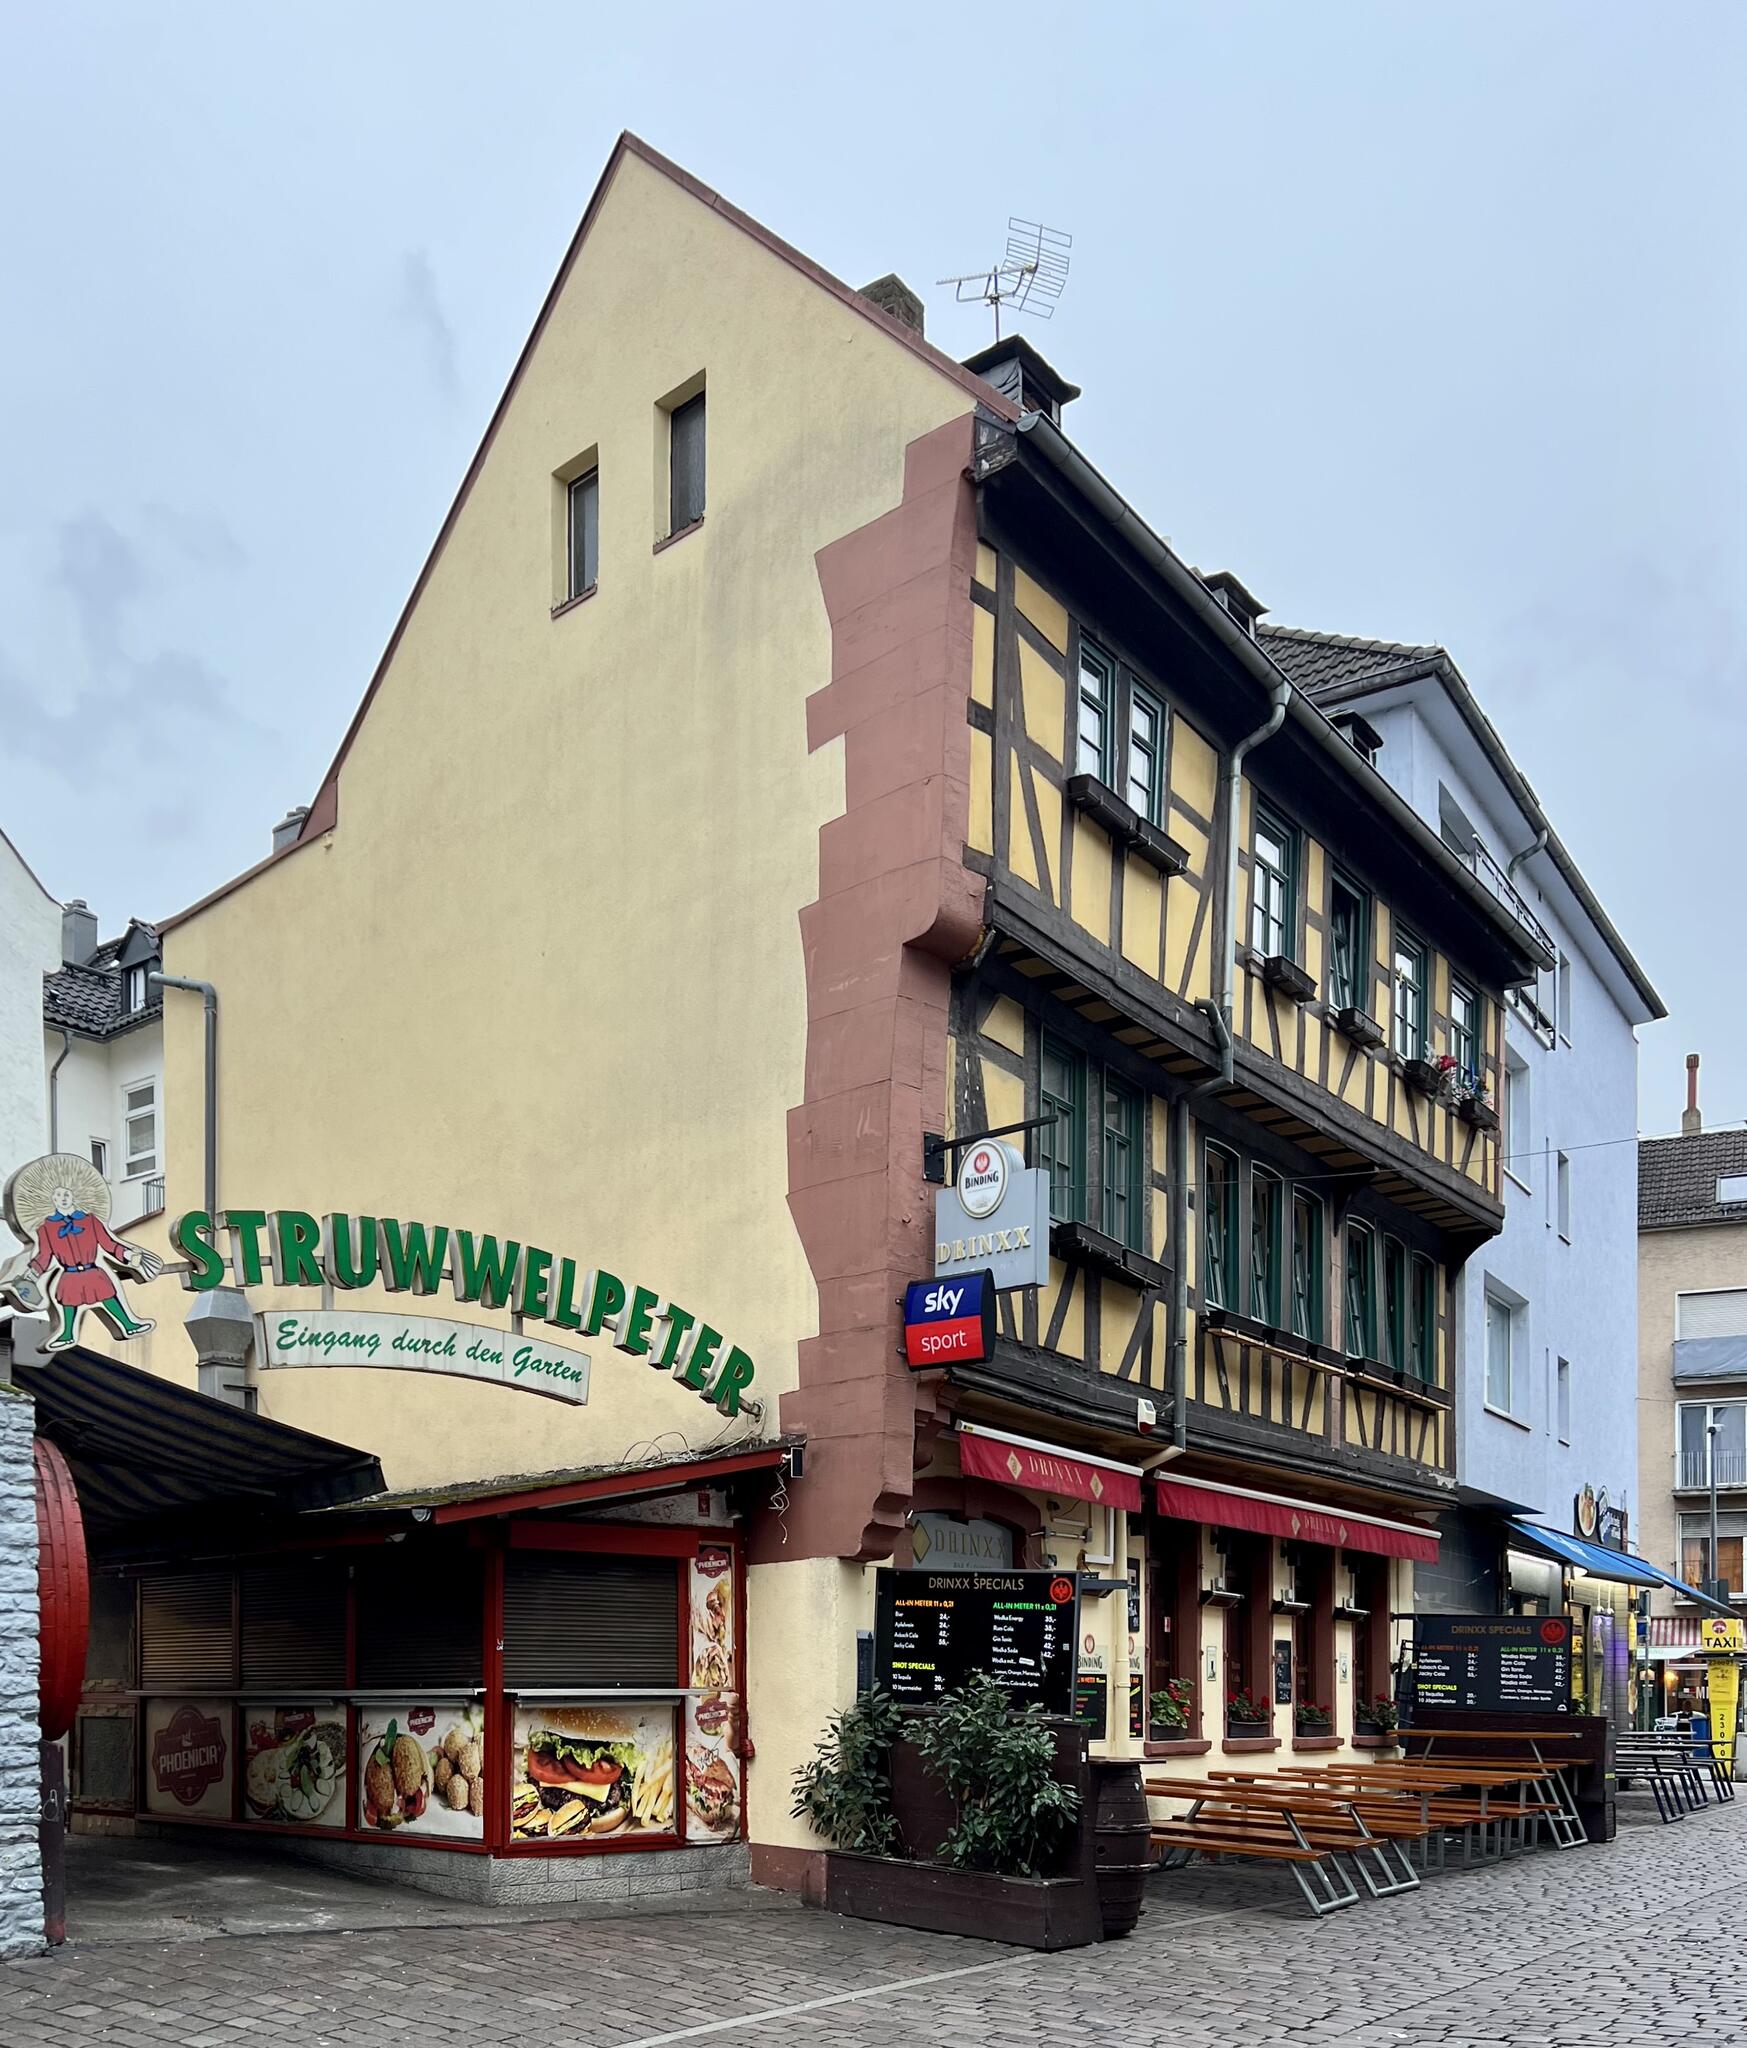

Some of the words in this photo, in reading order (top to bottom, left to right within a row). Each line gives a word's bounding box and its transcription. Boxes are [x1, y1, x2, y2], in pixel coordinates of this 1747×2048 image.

[965, 1171, 999, 1189] BINDING
[935, 1225, 1031, 1265] DRINXX
[170, 1210, 754, 1417] STRUWWELPETER
[924, 1285, 964, 1315] sky
[276, 1319, 382, 1357] Eingang
[391, 1328, 456, 1357] durch
[465, 1339, 504, 1364] den
[512, 1346, 584, 1384] Garten
[921, 1330, 967, 1355] sport
[935, 1528, 1008, 1560] DRINXX
[928, 1577, 970, 1589] DRINXX
[973, 1578, 1025, 1591] SPECIALS
[1451, 1625, 1486, 1635] DRINXX
[1489, 1626, 1532, 1635] SPECIALS
[1704, 1637, 1737, 1648] TAXI
[159, 1745, 218, 1774] PHOENICIA
